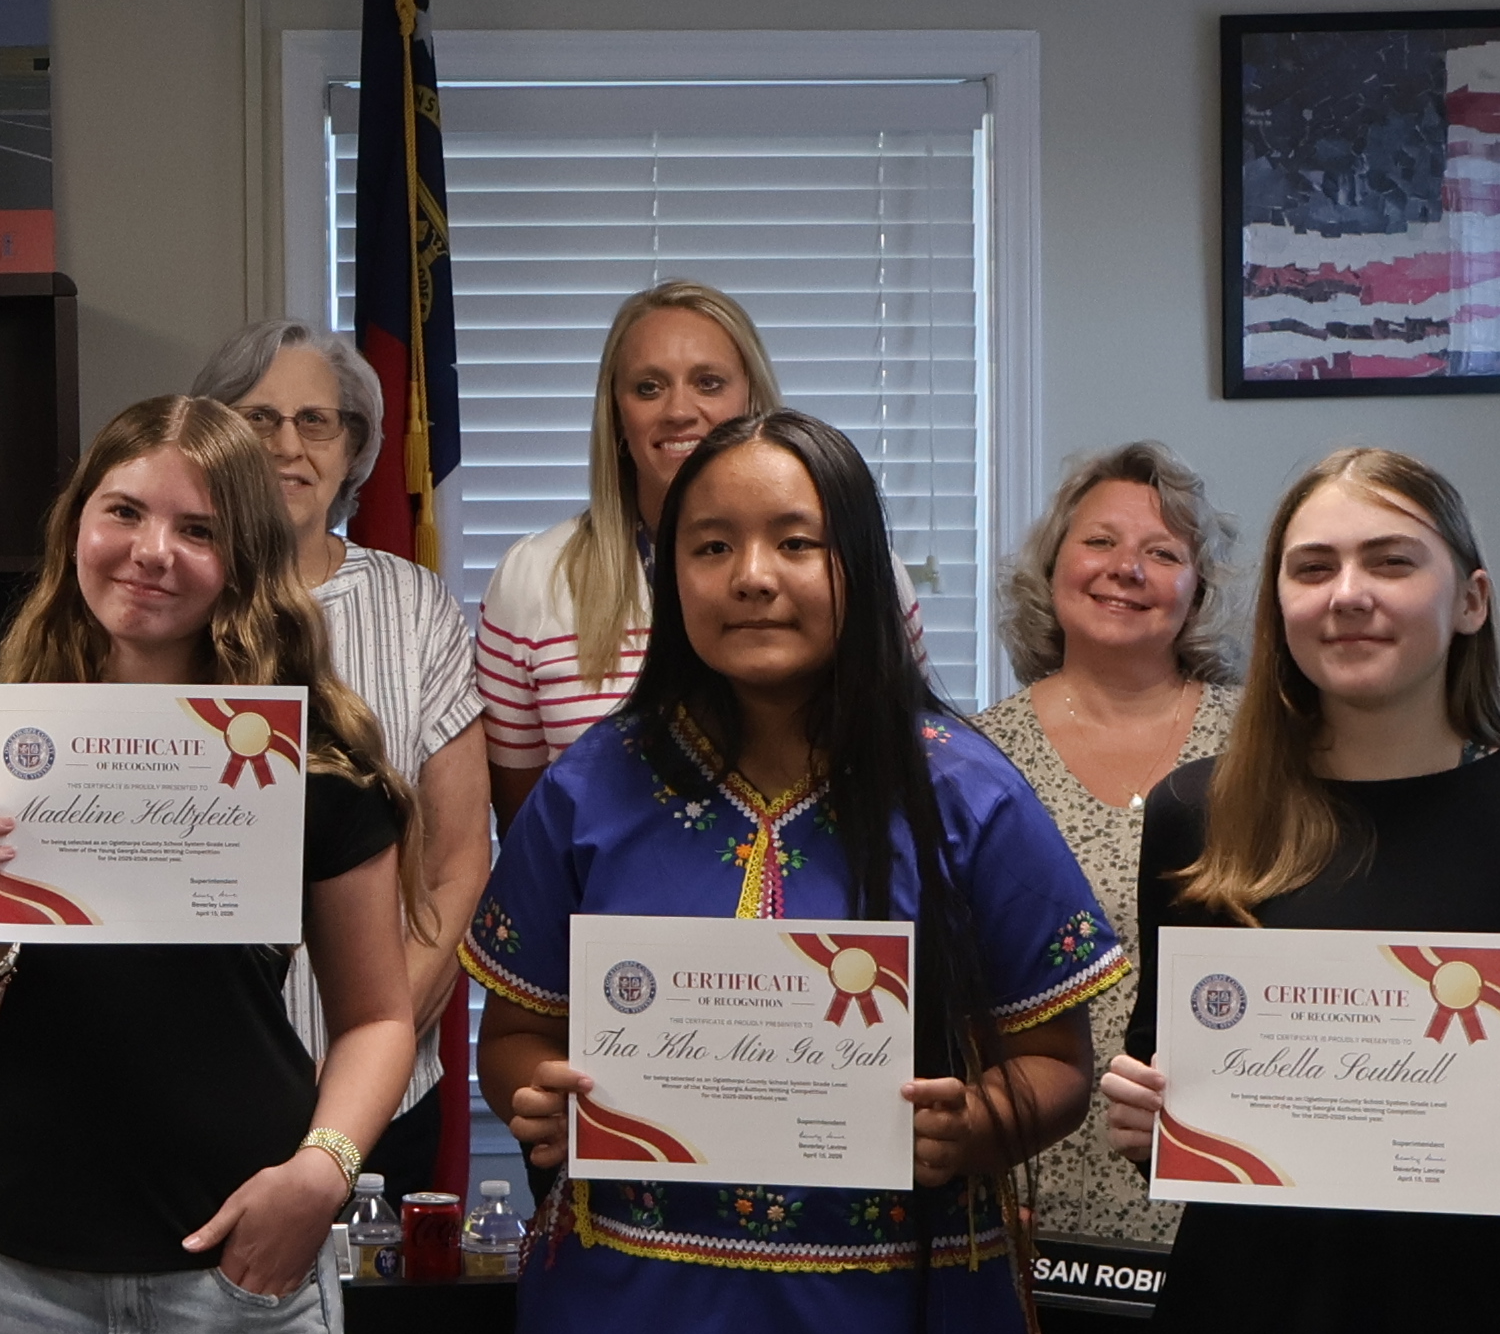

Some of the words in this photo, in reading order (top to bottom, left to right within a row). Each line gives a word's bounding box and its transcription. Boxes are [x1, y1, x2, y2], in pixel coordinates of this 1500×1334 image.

[71, 736, 205, 755] CERTIFICATE
[96, 762, 110, 770] OF
[111, 762, 179, 771] RECOGNITION
[20, 794, 125, 825] Madeline
[671, 970, 810, 992] CERTIFICATE
[698, 996, 711, 1005] OF
[713, 997, 783, 1007] RECOGNITION
[1262, 984, 1410, 1007] CERTIFICATE
[1290, 1012, 1305, 1020] OF
[1306, 1012, 1381, 1023] RECOGNITION
[582, 1026, 638, 1058] Tha
[651, 1029, 706, 1060] Kho
[714, 1033, 775, 1063] Min
[831, 1036, 892, 1070] Yah
[1211, 1047, 1324, 1079] Isabella
[1338, 1051, 1457, 1084] Southall
